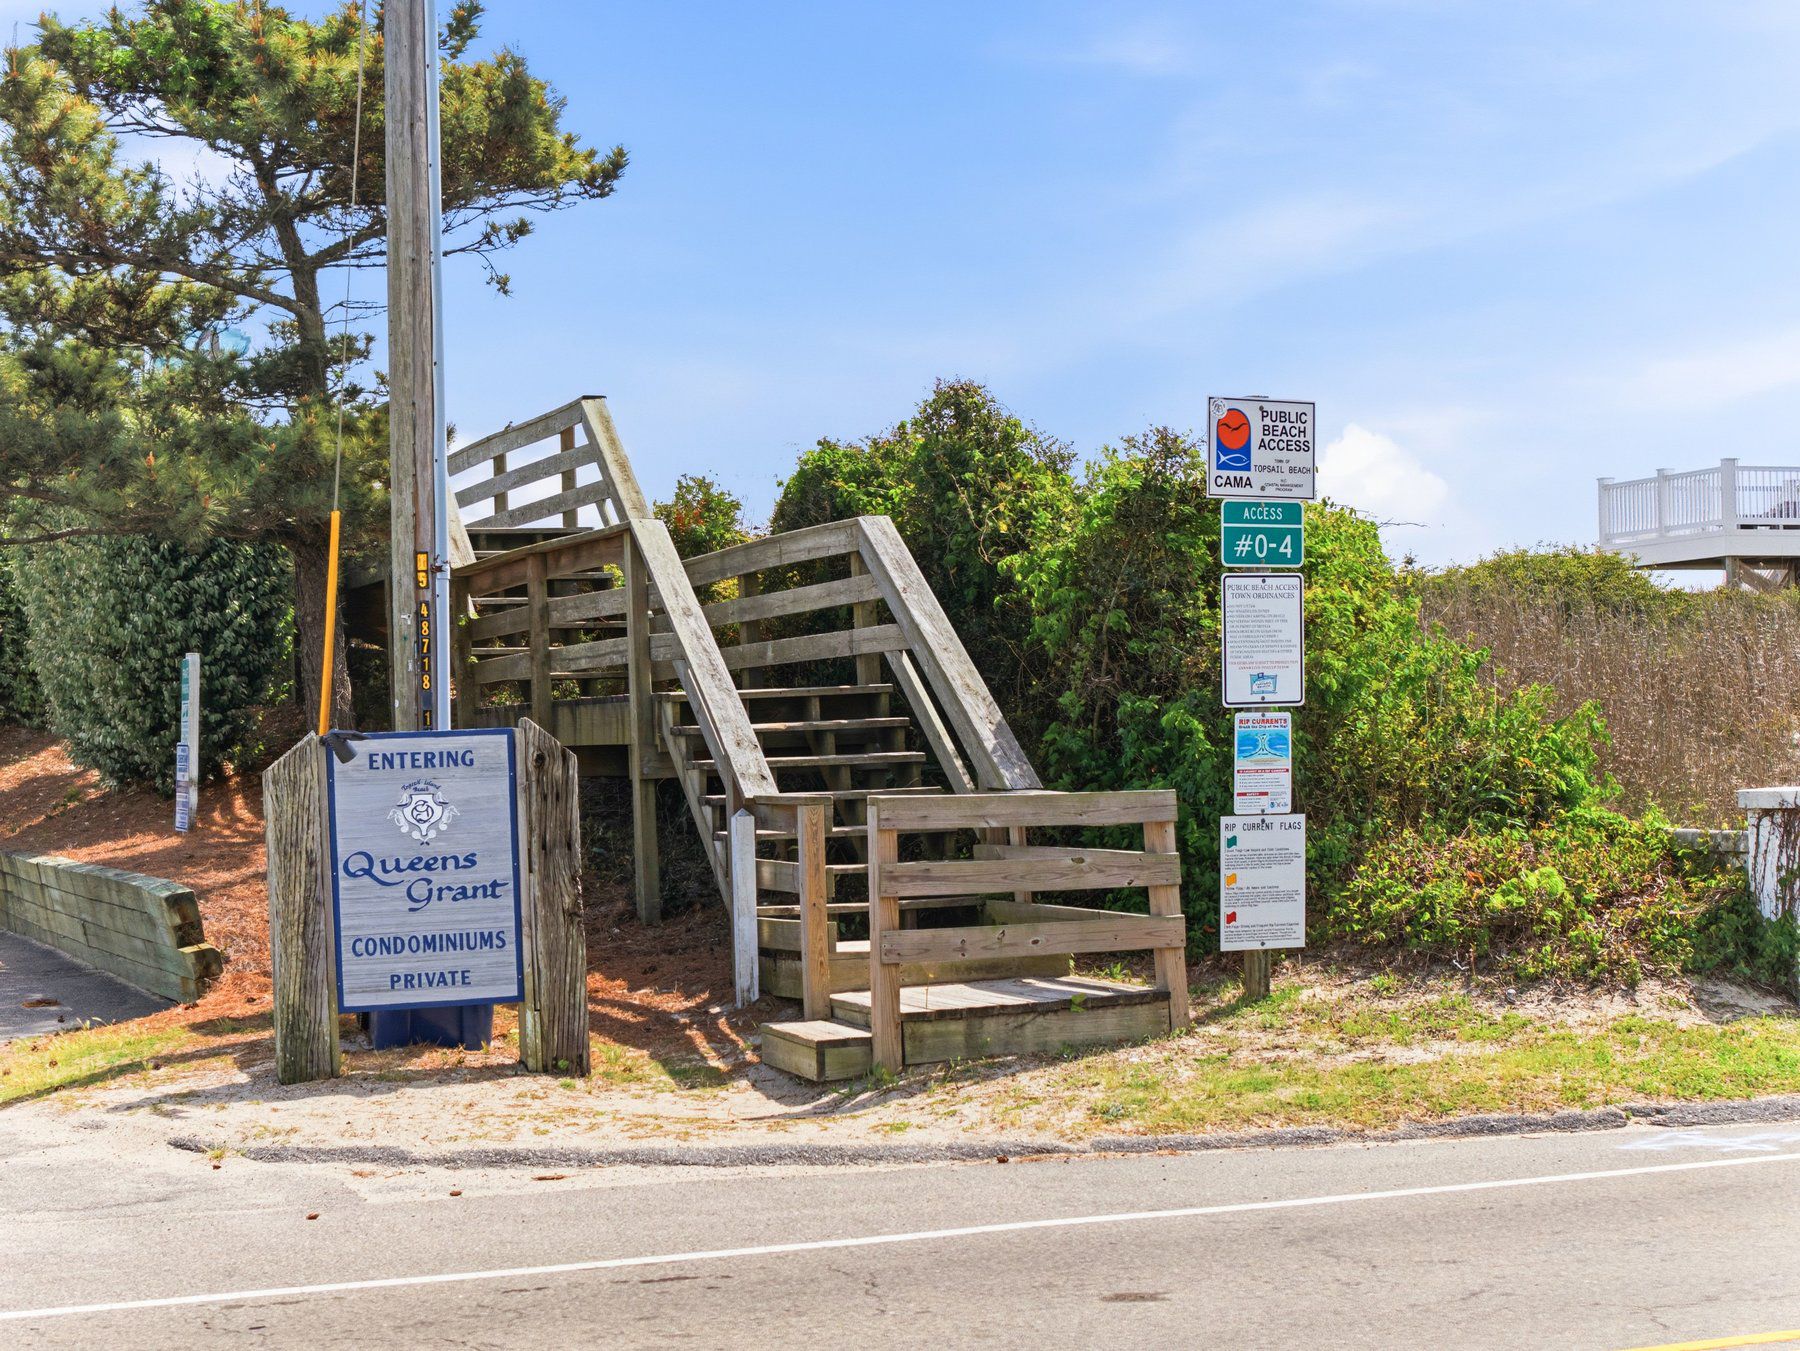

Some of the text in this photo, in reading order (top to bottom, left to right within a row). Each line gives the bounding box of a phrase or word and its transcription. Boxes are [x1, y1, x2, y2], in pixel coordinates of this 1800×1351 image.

[1261, 410, 1308, 424] PUBLIC
[1262, 424, 1306, 438] BEACH
[1258, 438, 1311, 452] ACCESS
[1253, 465, 1311, 474] TOPSAIL BEACH
[1214, 475, 1253, 489] CAMA
[1243, 507, 1283, 520] ACCESS
[368, 750, 475, 770] ENTERING
[401, 778, 422, 790] Topsail
[1224, 821, 1302, 832] RIP CURRENT FLAGS
[342, 851, 478, 887] Queens
[406, 877, 509, 912] Grant
[351, 930, 507, 957] CONDOMINIUMS
[389, 969, 472, 990] PRIVATE
